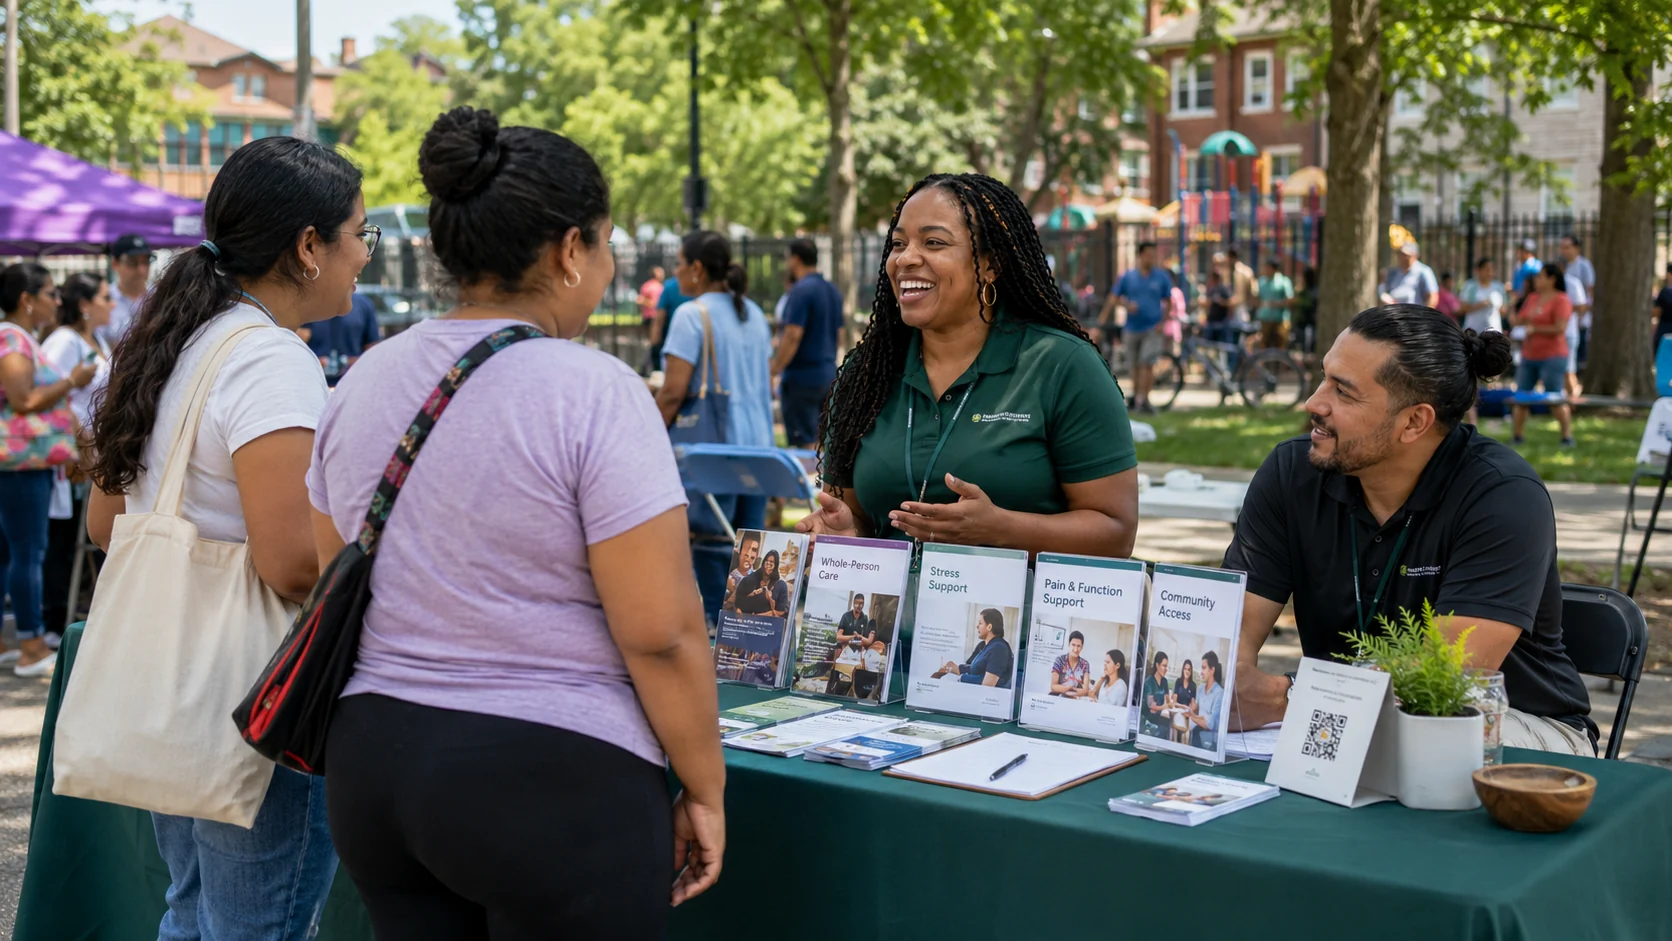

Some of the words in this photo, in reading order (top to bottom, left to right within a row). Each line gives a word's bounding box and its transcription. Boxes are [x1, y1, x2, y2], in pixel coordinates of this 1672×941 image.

[821, 557, 880, 572] Whole-Person
[930, 566, 960, 578] Stress
[818, 570, 839, 581] Care
[928, 580, 968, 594] Support
[1044, 578, 1066, 591] Pain
[1067, 581, 1076, 592] &
[1078, 582, 1123, 597] Function
[1043, 593, 1085, 608] Support
[1160, 590, 1216, 611] Community
[1158, 605, 1192, 621] Access
